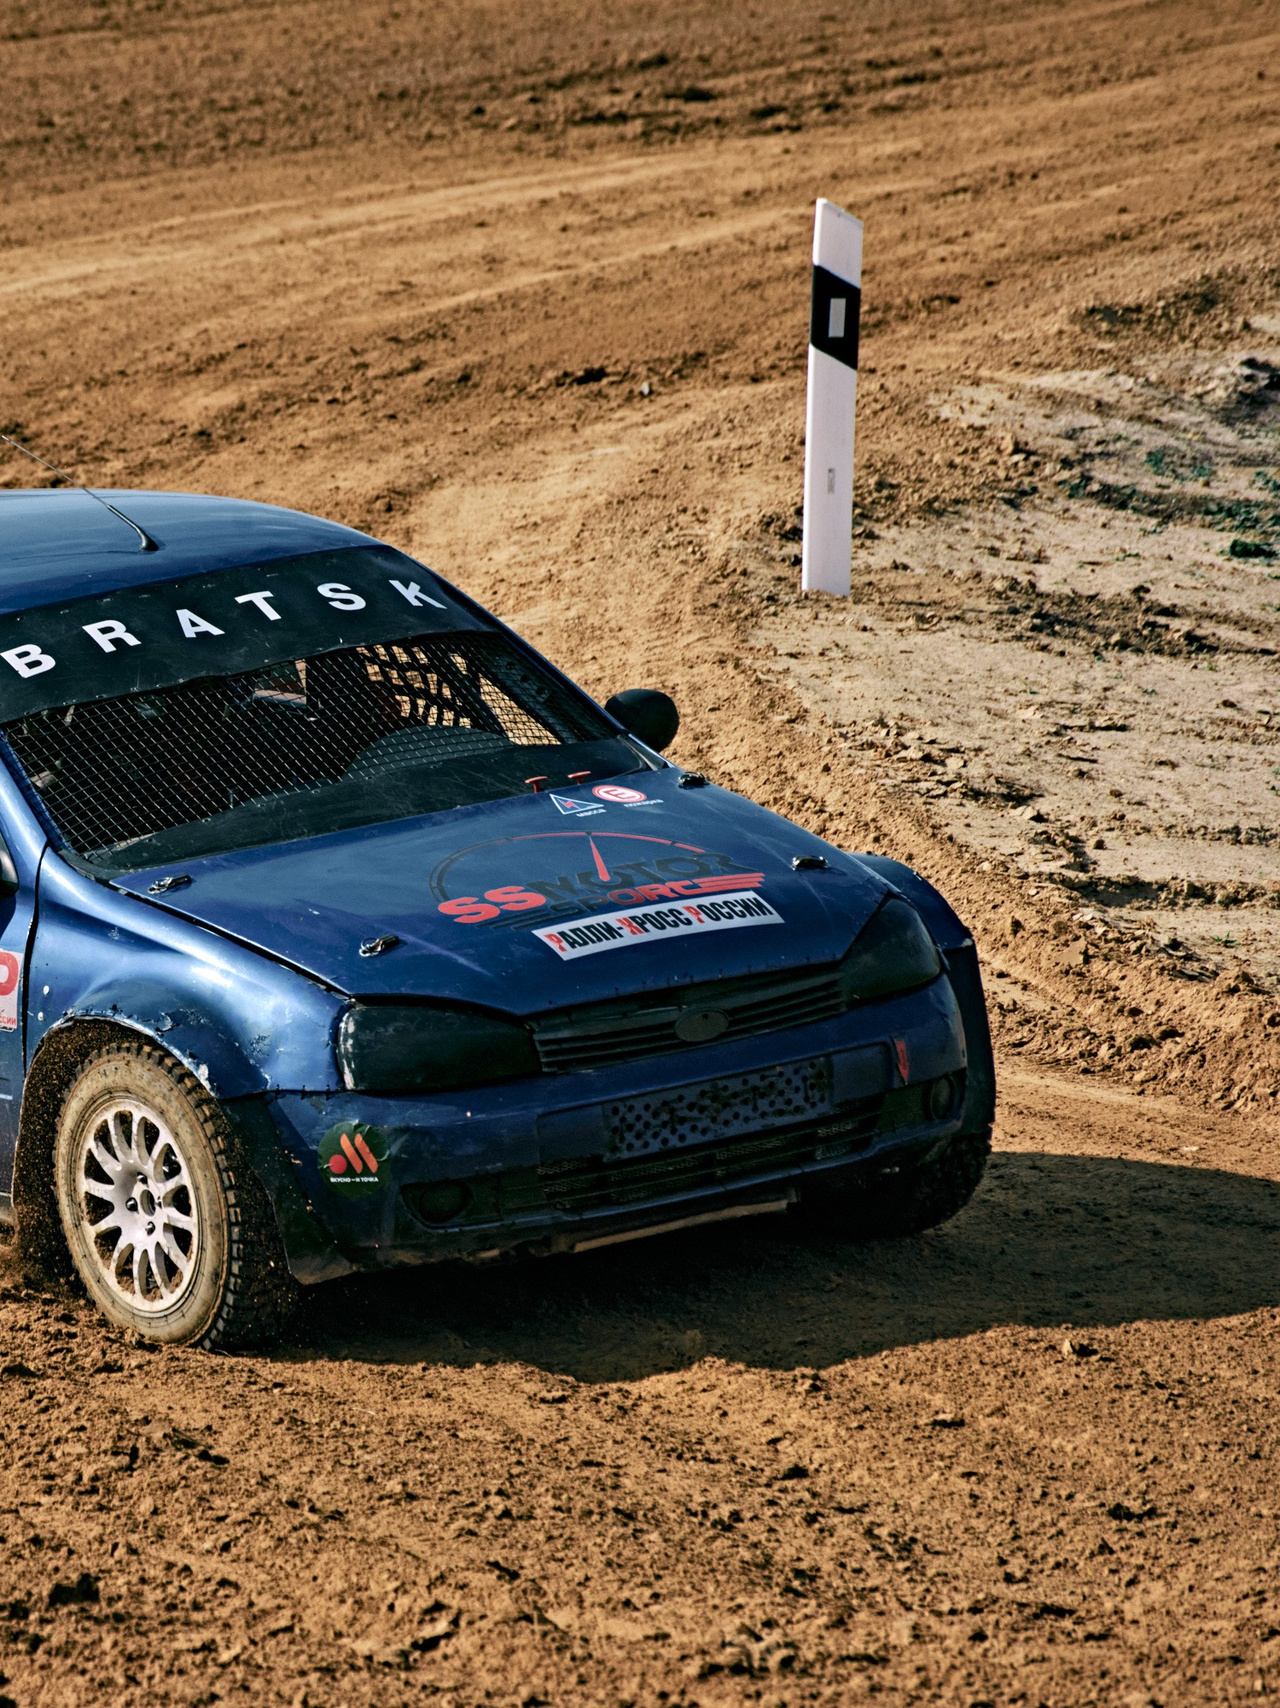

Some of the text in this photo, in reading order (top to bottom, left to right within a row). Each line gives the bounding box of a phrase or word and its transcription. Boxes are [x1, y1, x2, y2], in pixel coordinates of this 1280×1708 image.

[0, 578, 448, 679] BRATSK
[544, 896, 775, 953] РАЛЛИ-КРОСС РОССИИ
